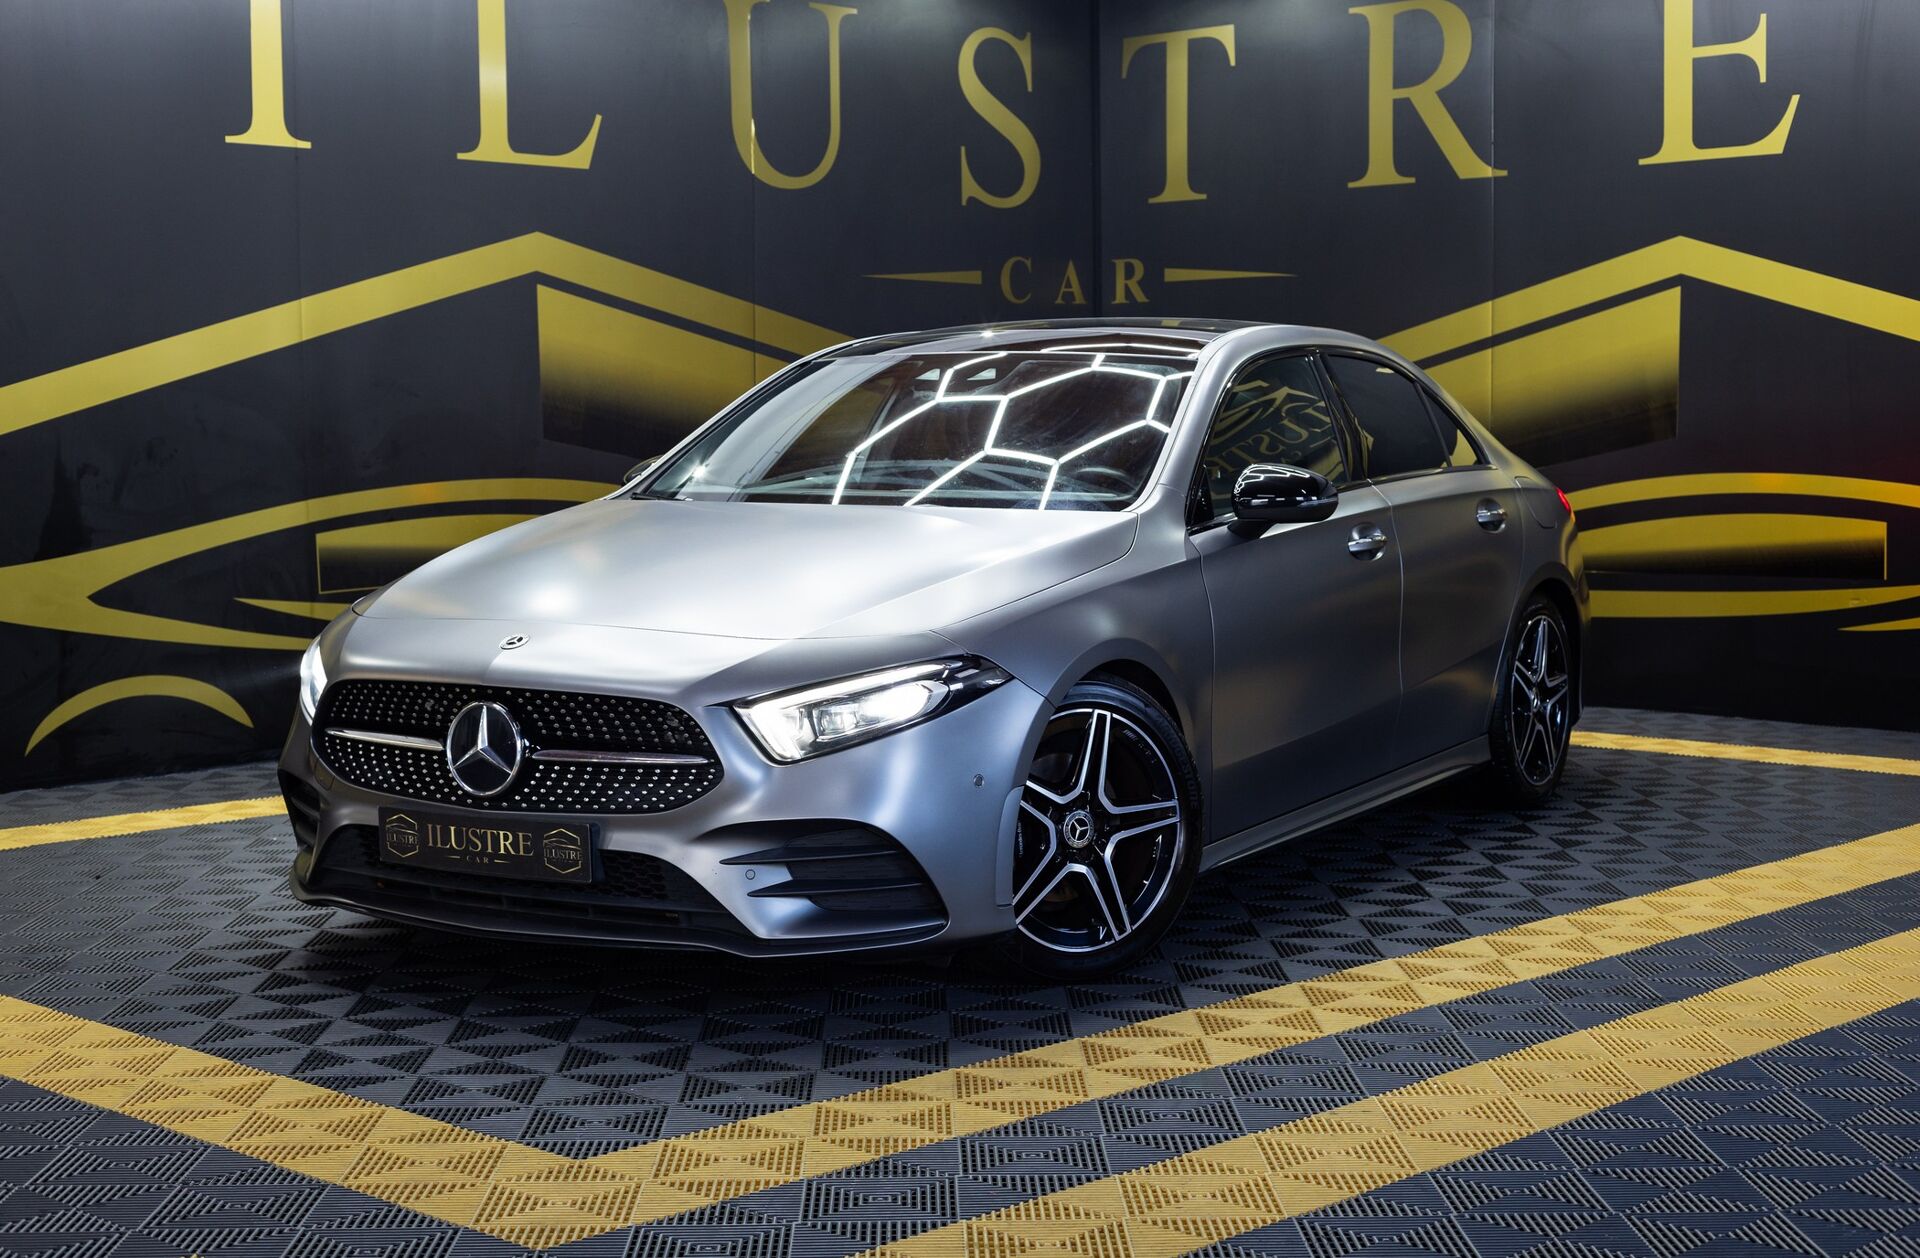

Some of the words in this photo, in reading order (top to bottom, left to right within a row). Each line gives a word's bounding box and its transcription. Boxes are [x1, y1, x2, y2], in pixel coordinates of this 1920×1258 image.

[224, 0, 1801, 209] ILUSTRE
[1000, 256, 1148, 305] CAR
[427, 823, 534, 857] ILUSTRE
[544, 848, 583, 861] ILUSTRE
[466, 854, 489, 864] CAR
